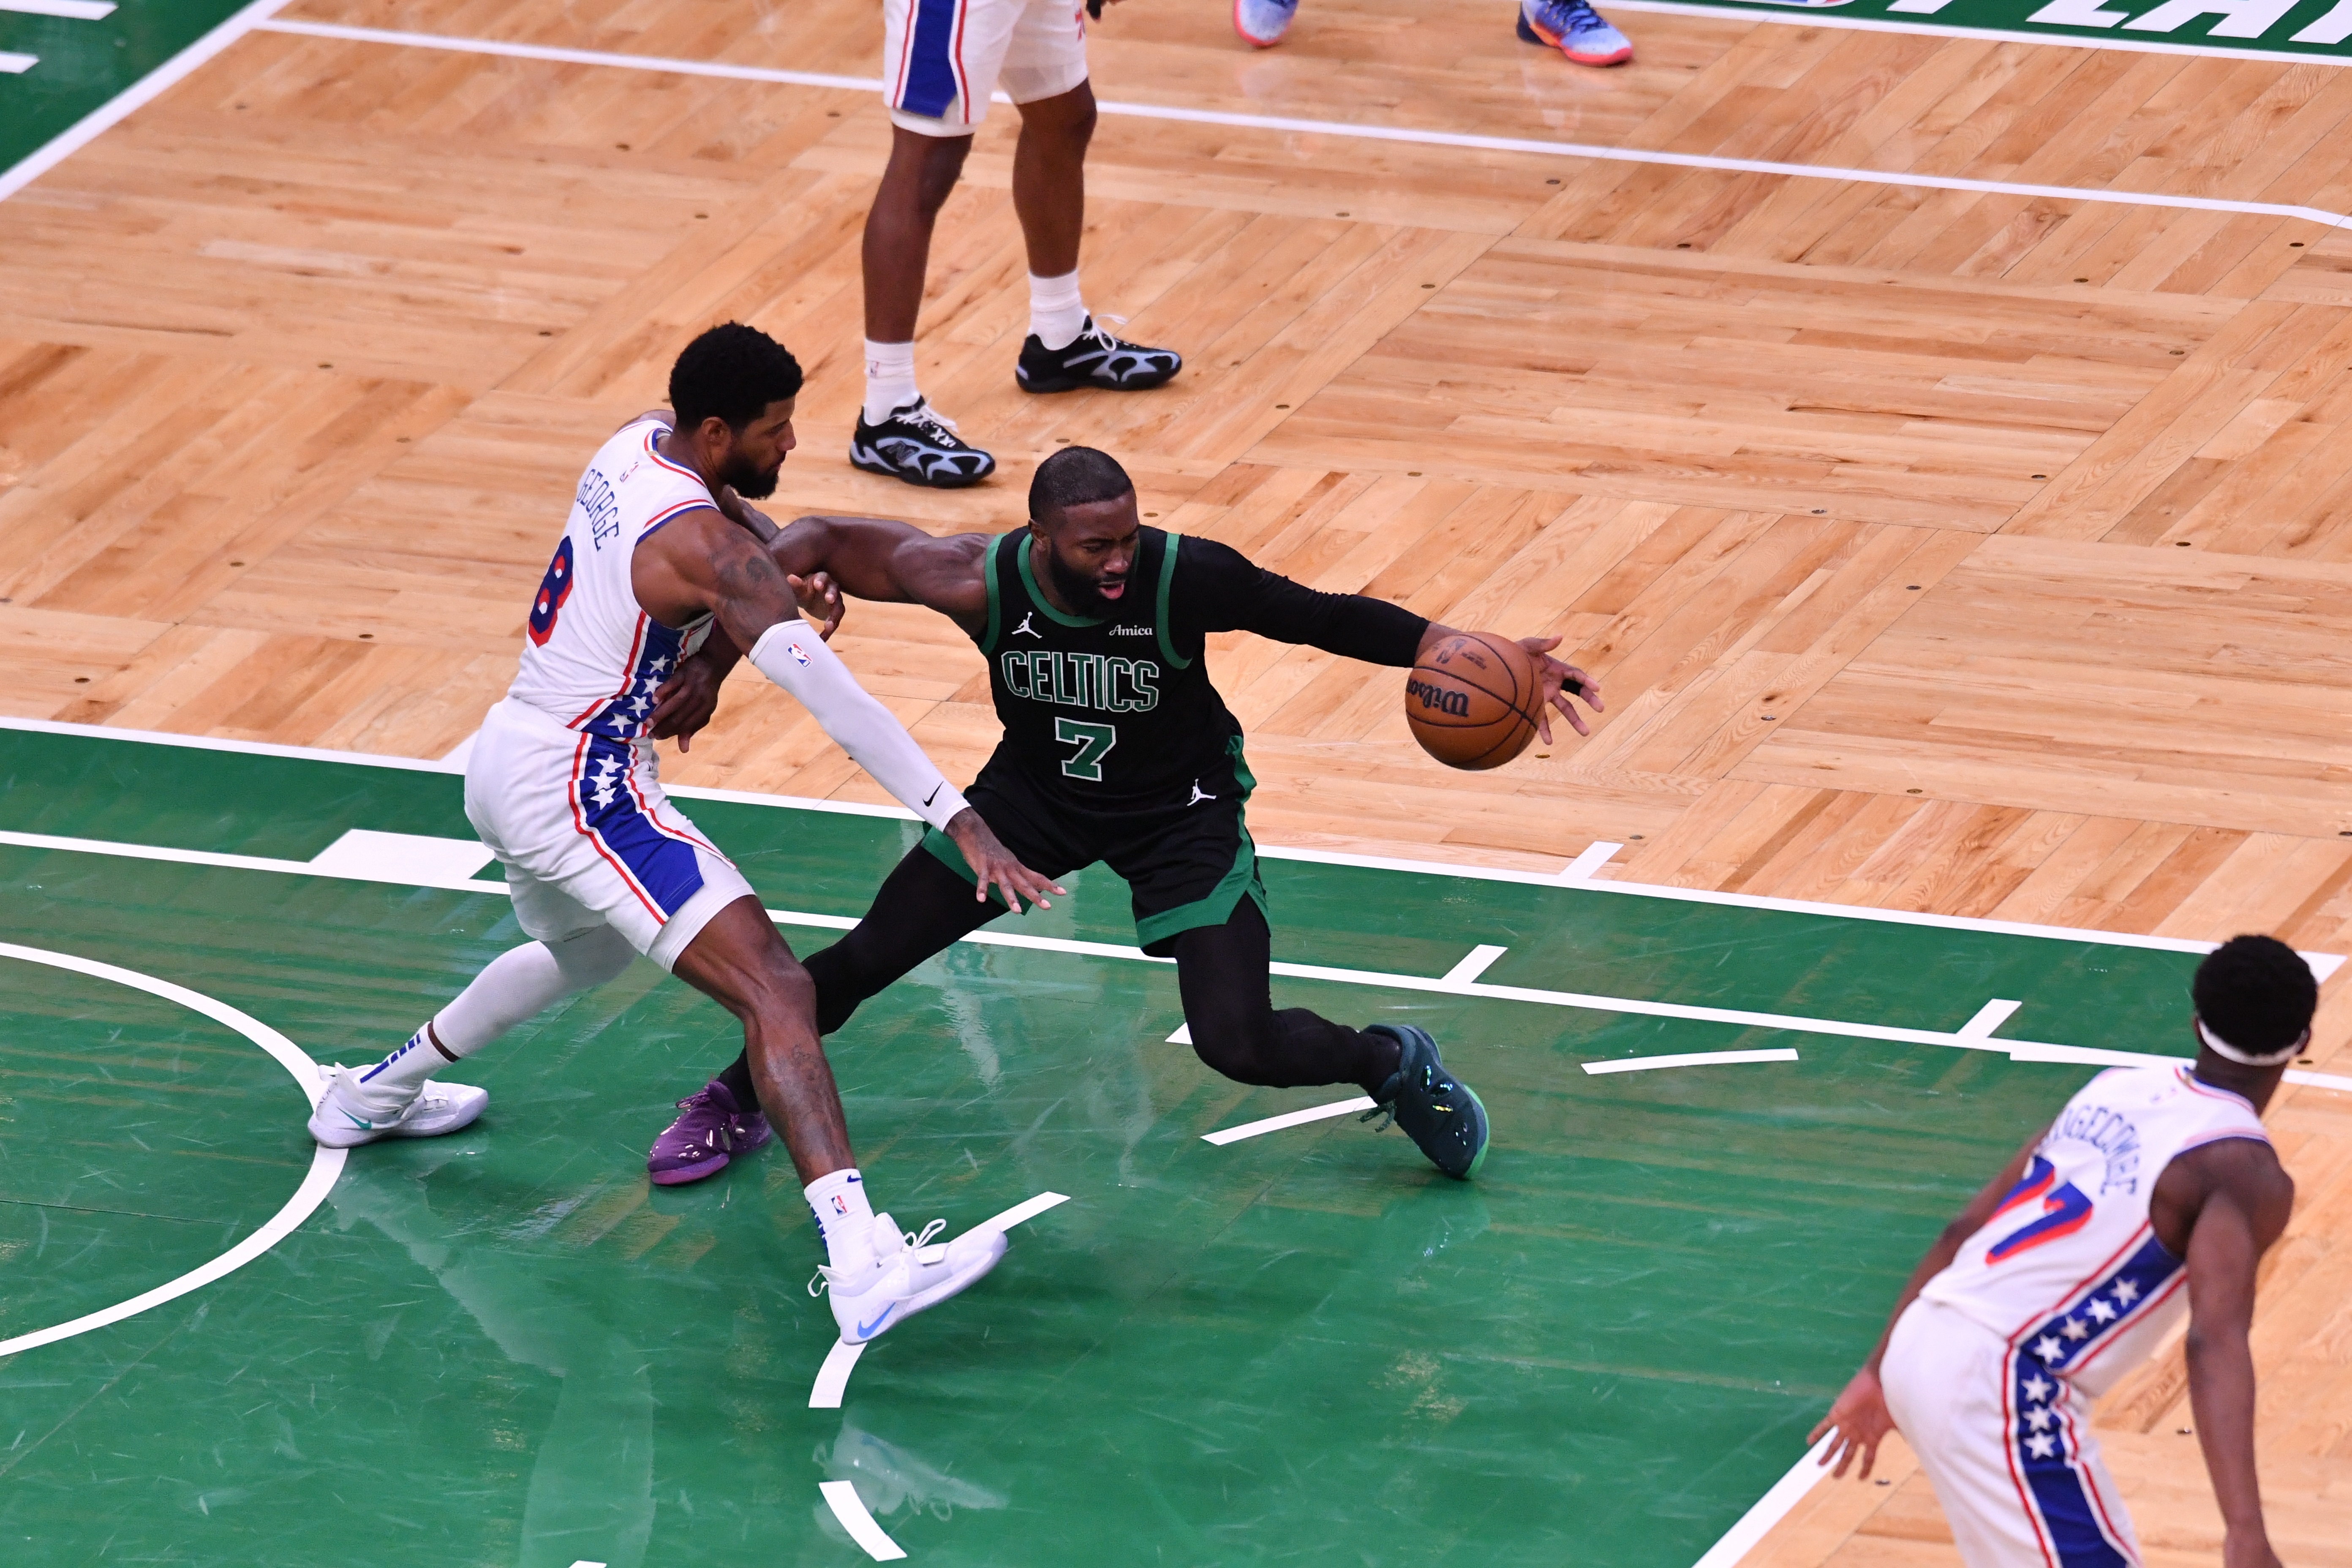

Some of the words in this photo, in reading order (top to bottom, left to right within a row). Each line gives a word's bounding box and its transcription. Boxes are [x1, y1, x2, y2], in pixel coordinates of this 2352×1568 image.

[576, 468, 620, 552] GEORGE
[528, 535, 573, 648] 8
[1109, 624, 1153, 636] Amica
[1001, 651, 1159, 712] CELTICS
[1055, 716, 1116, 781] 7
[1985, 1154, 2093, 1267] 77
